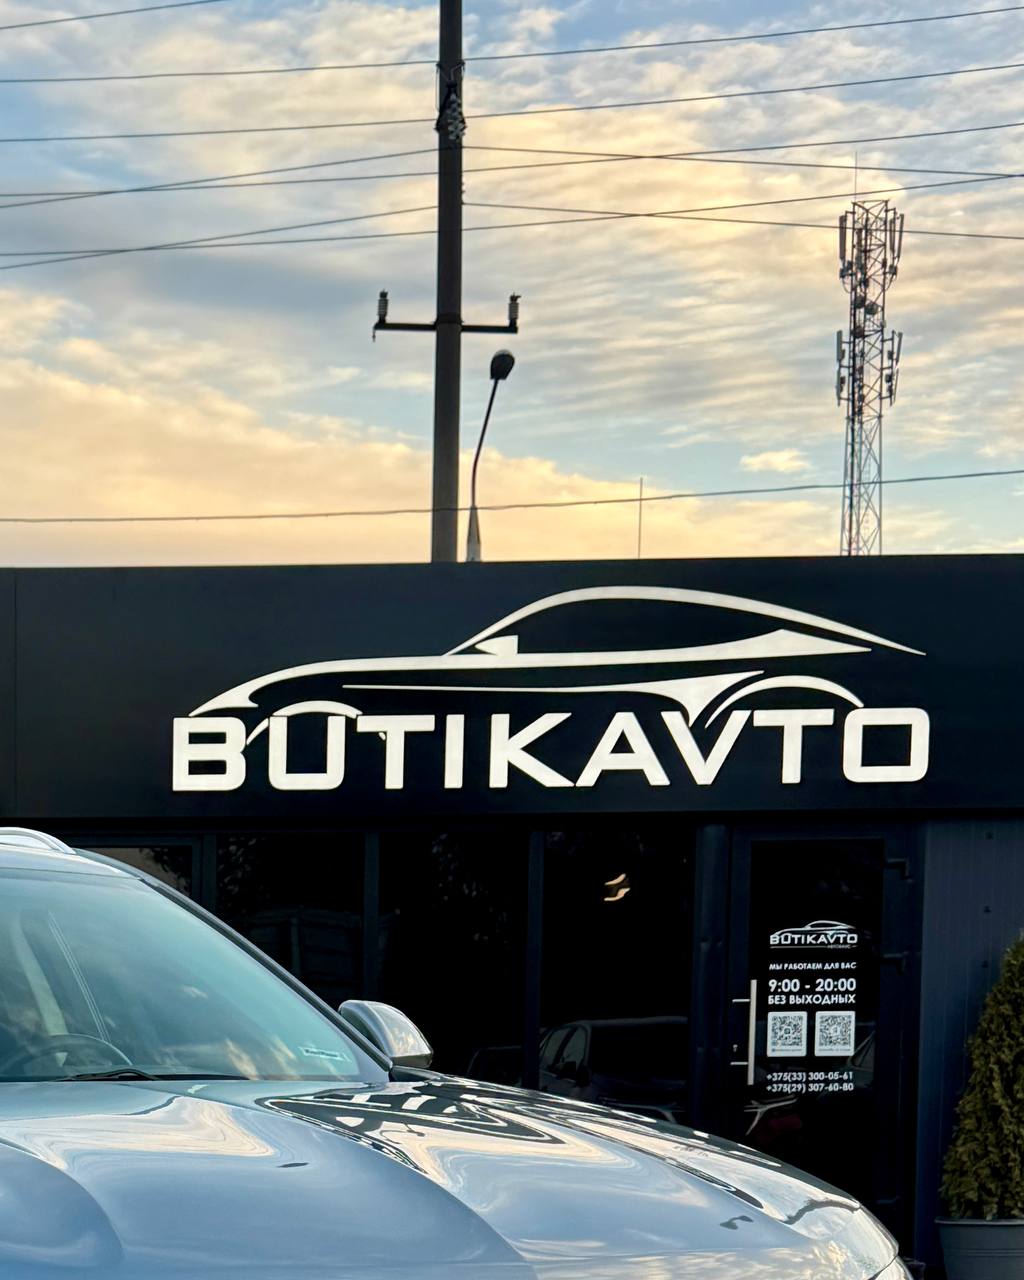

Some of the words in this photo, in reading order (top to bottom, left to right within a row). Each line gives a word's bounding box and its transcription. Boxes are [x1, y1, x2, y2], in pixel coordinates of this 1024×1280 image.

[172, 706, 931, 792] BUTIKAVTO
[769, 933, 858, 945] BUTIKAVTO
[784, 962, 823, 970] РАБОТАЕМ
[841, 961, 857, 969] ВАС
[768, 979, 800, 992] 9:00
[815, 978, 856, 991] 20:00
[768, 994, 786, 1005] БЕЗ
[789, 993, 856, 1005] ВЫХОДНЫХ
[766, 1072, 806, 1082] +375(33)
[808, 1071, 853, 1080] 300-05-61
[766, 1083, 806, 1093] +375(29)
[808, 1083, 854, 1091] 307-60-80
